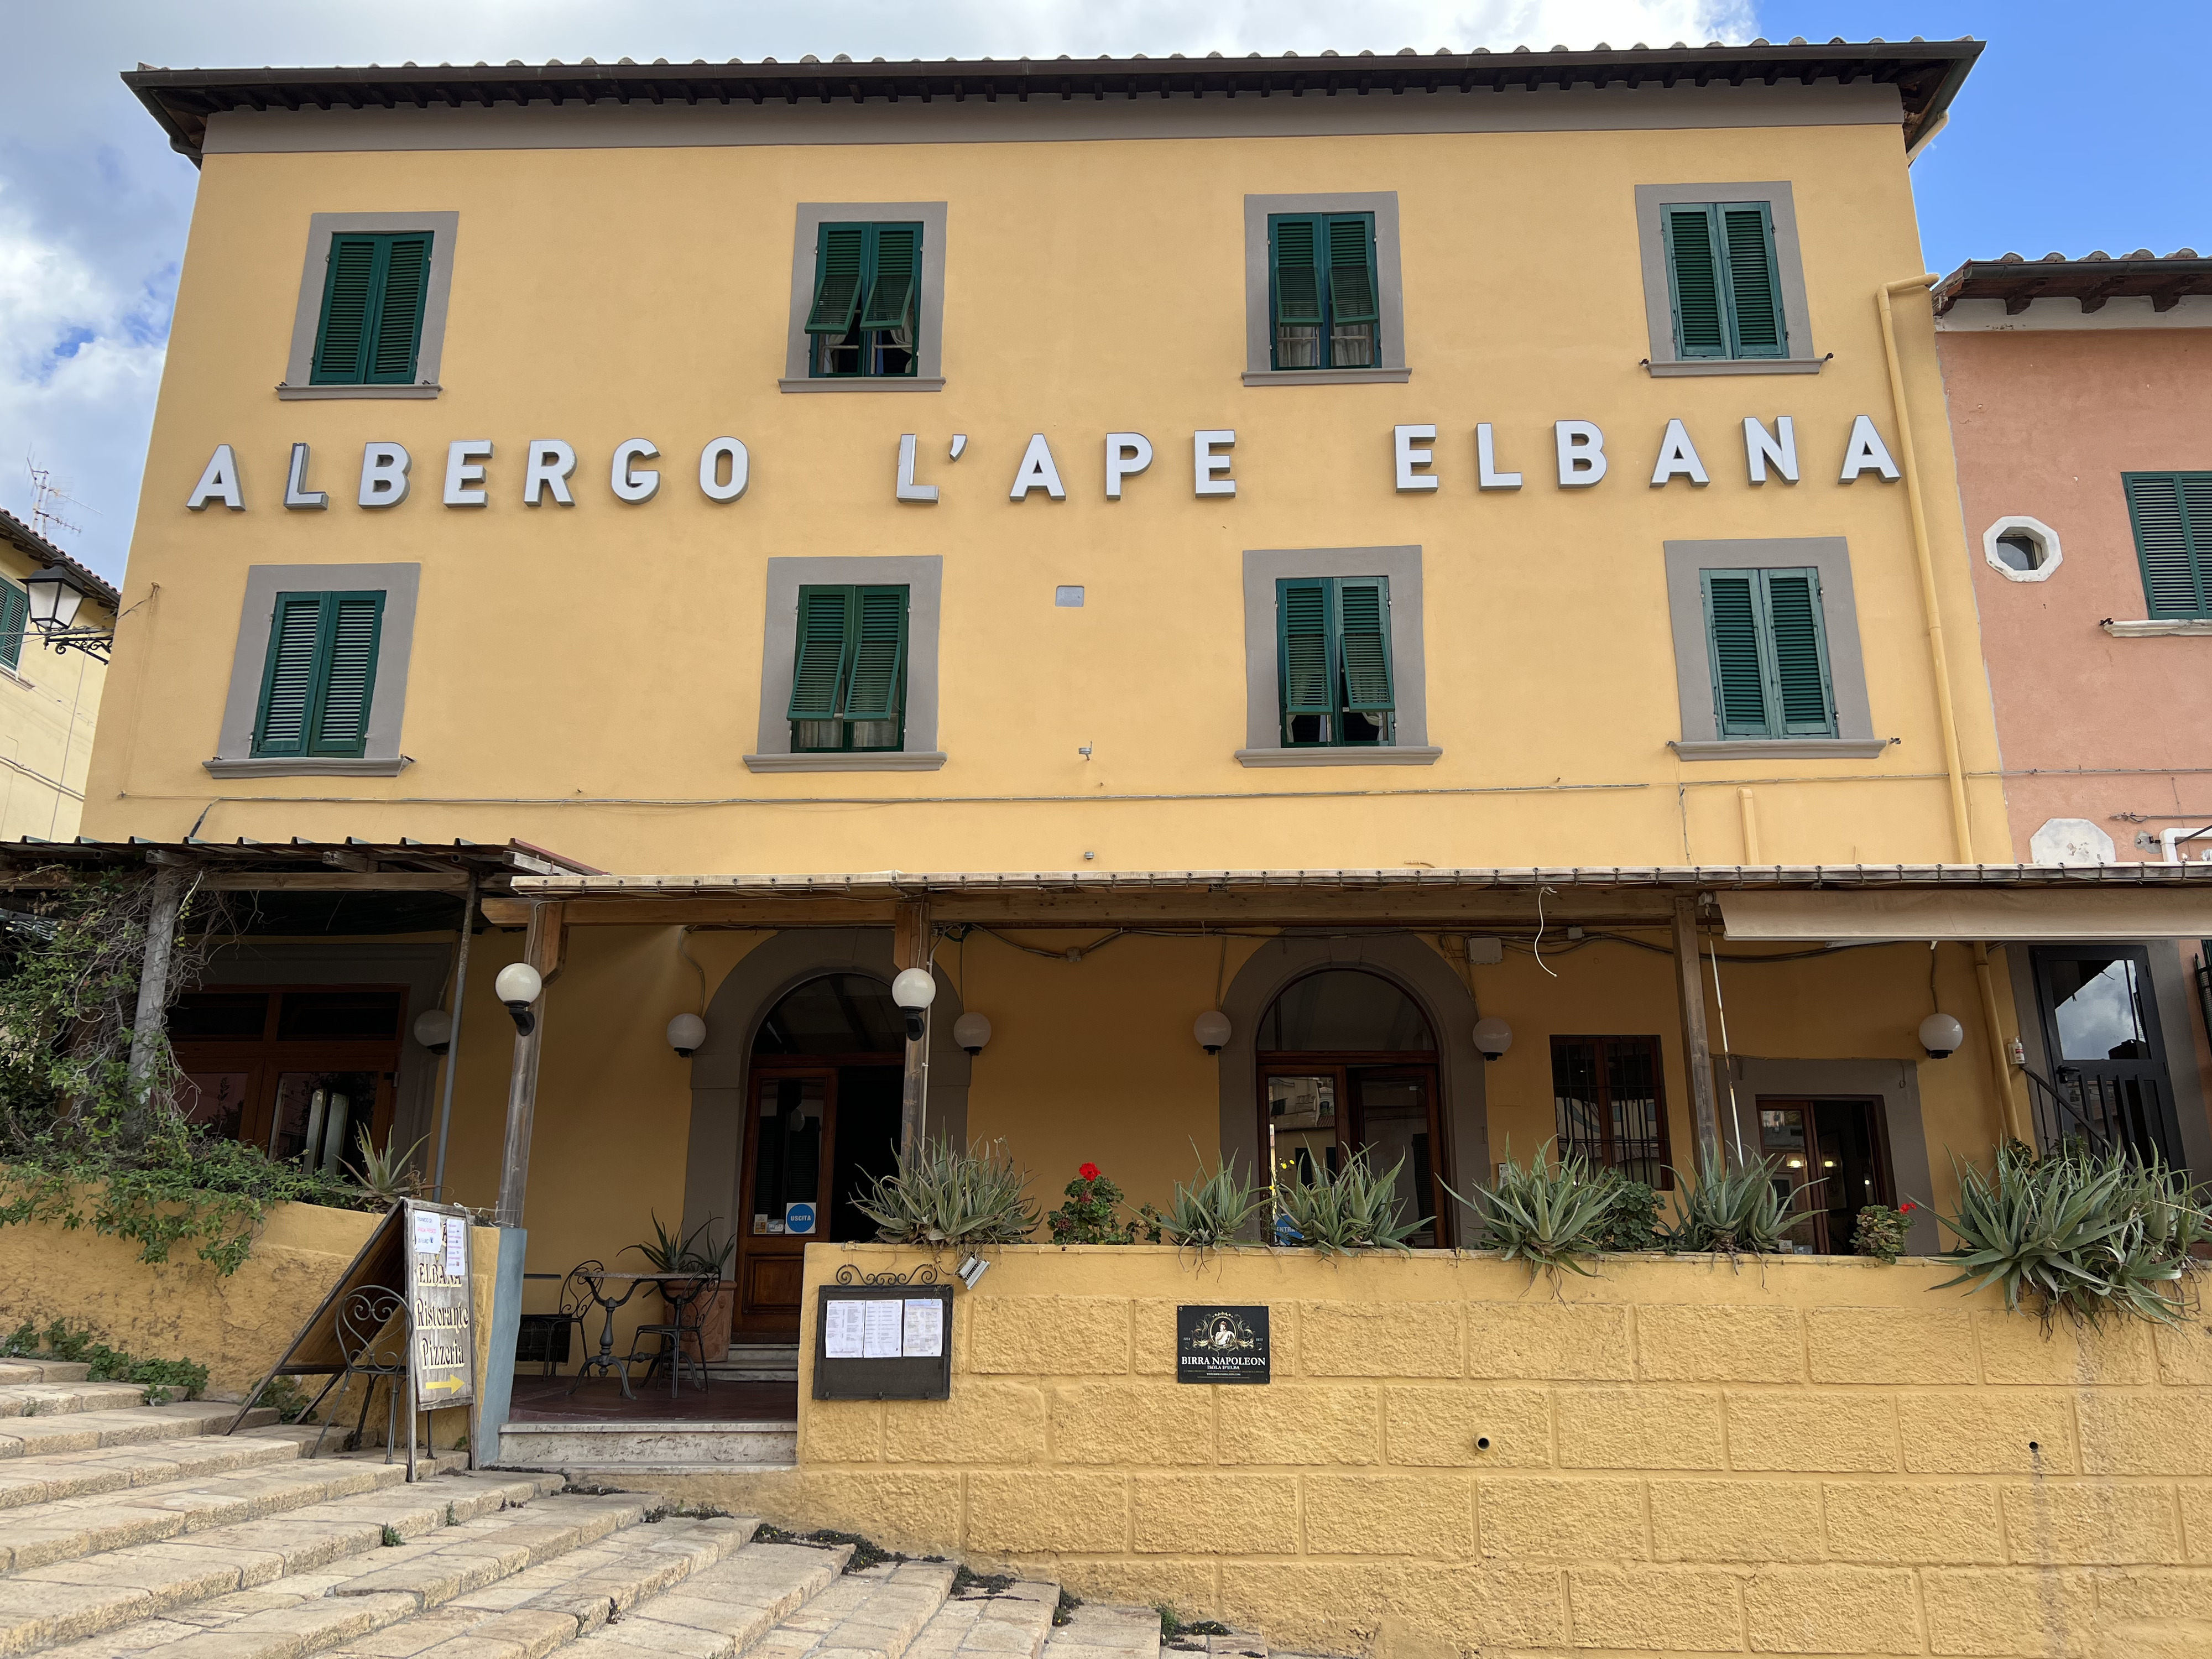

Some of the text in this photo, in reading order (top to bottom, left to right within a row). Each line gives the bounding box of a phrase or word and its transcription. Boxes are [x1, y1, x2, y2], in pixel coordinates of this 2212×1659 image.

[186, 415, 1902, 512] ALBERGO L'APE ELBANA
[415, 1297, 469, 1334] Ristorante
[421, 1338, 465, 1370] Pizzeria
[1181, 1356, 1266, 1366] BIRRA NAPOLEON
